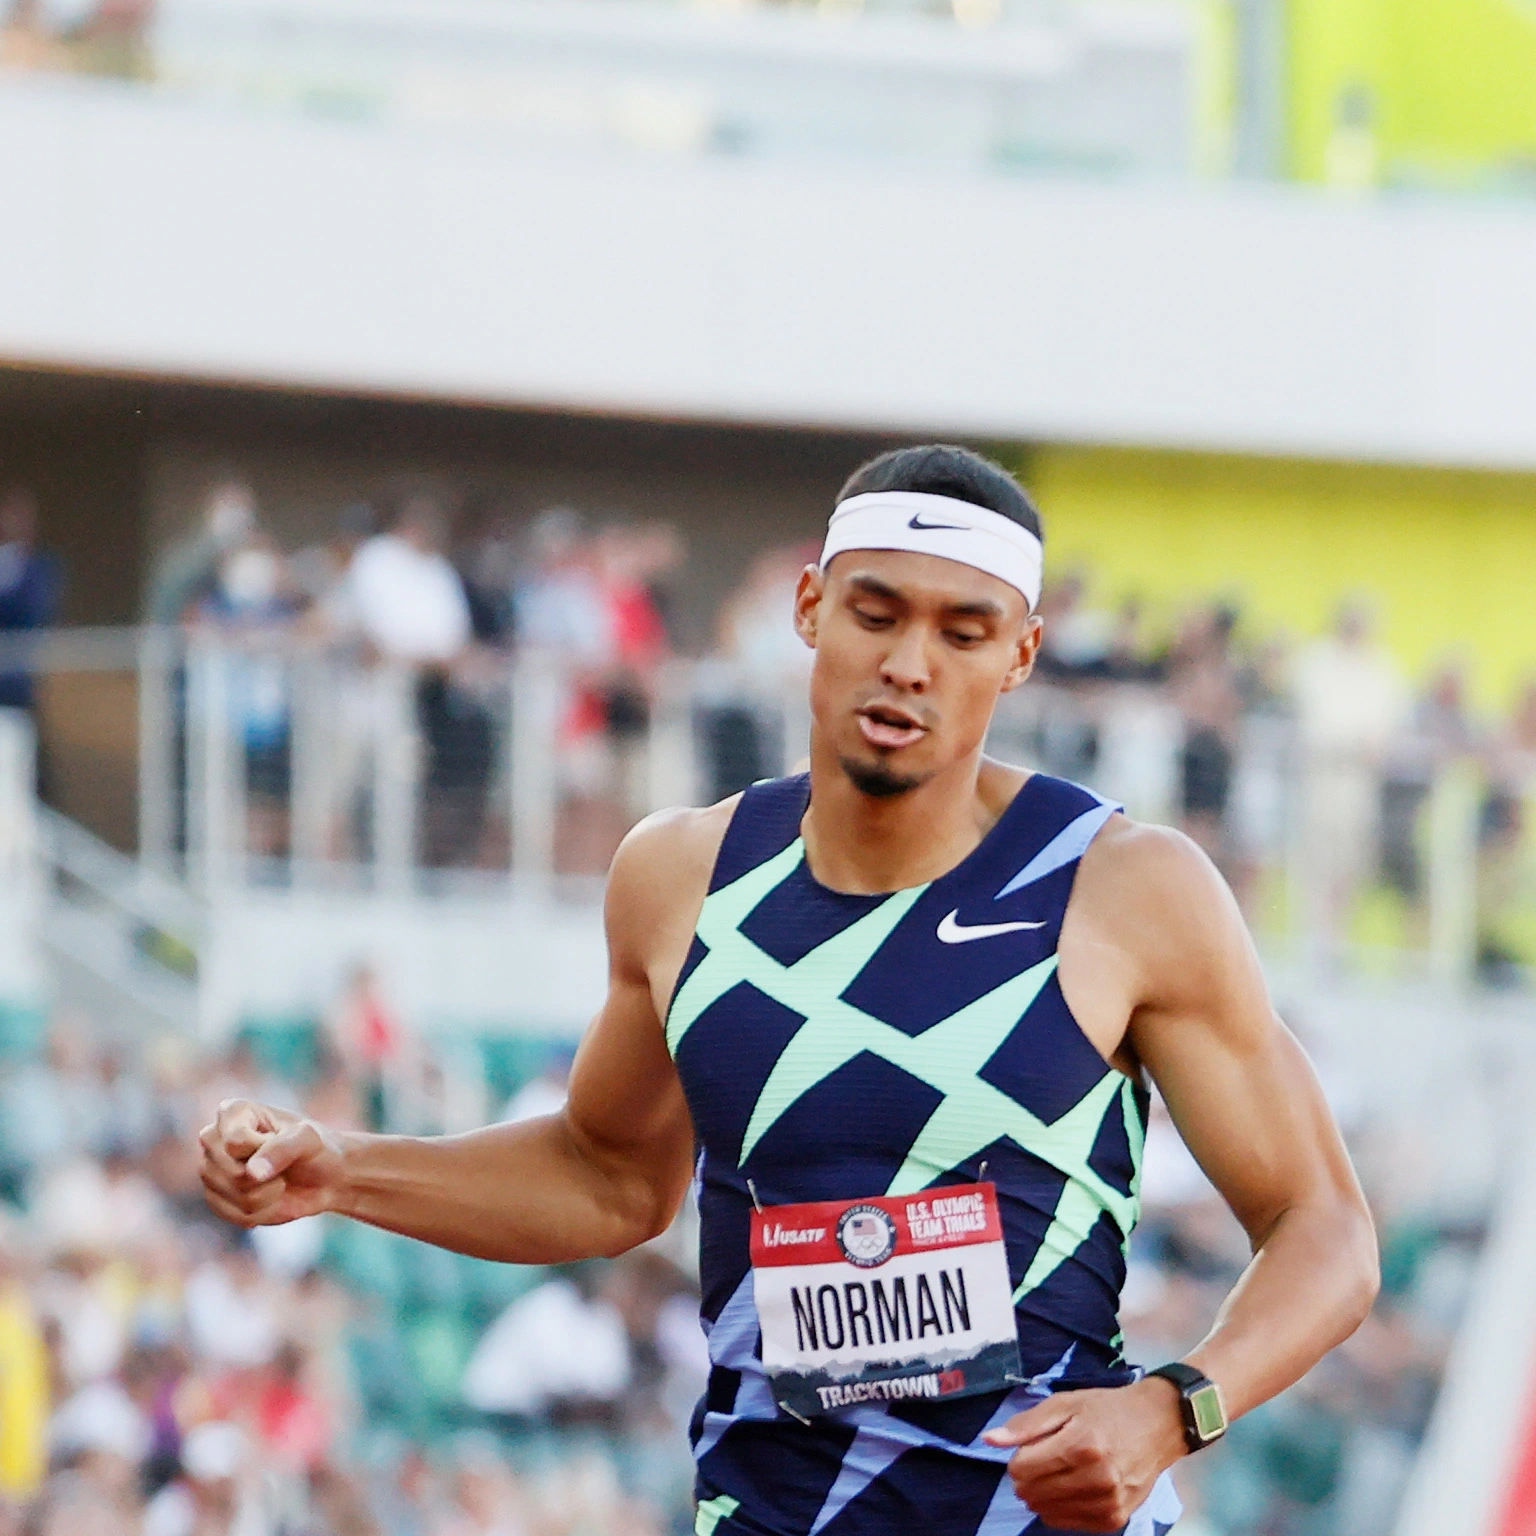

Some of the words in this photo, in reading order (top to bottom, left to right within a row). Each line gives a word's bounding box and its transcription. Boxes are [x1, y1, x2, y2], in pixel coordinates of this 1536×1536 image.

[906, 1201, 931, 1221] U.S.
[931, 1192, 986, 1218] OLYMPIC
[908, 1218, 945, 1240] TEAM
[943, 1211, 987, 1234] TRIALS
[790, 1267, 972, 1352] NORMAN
